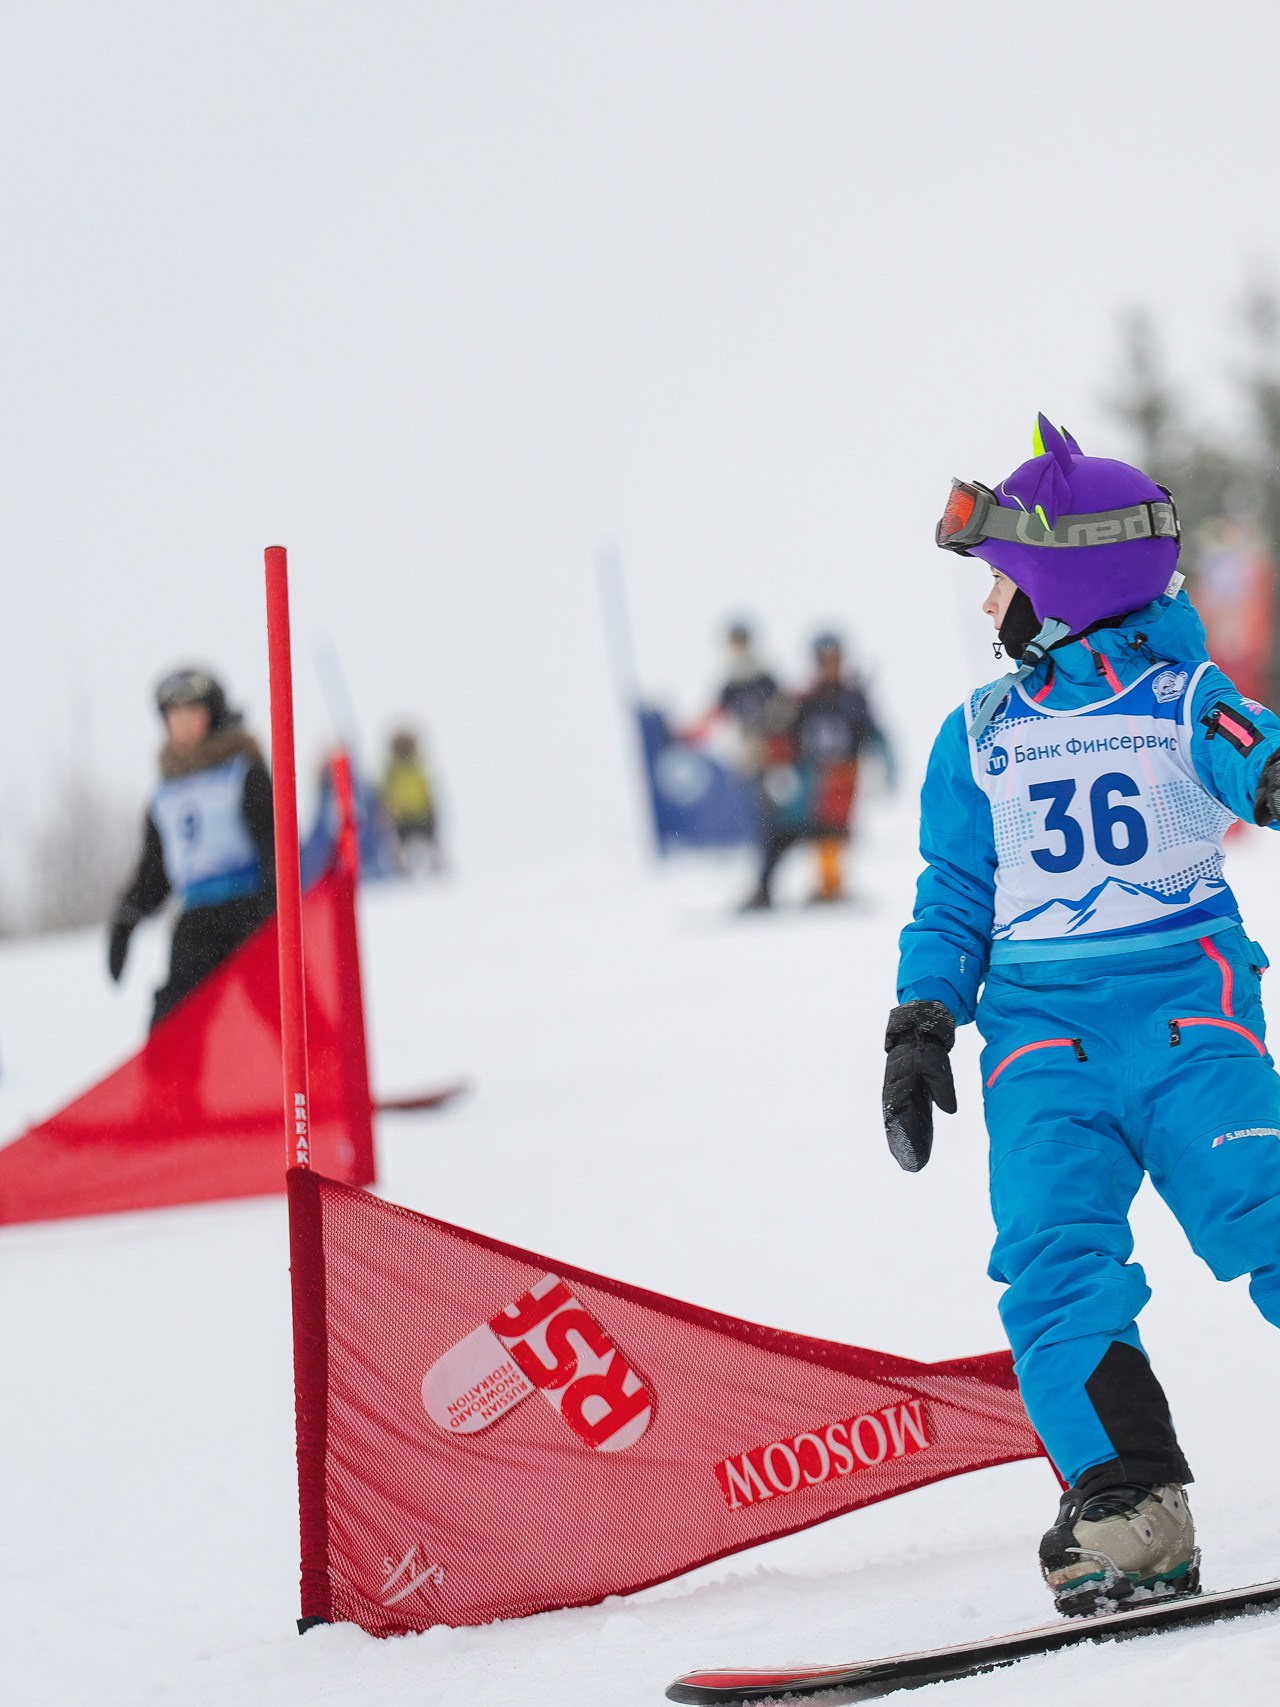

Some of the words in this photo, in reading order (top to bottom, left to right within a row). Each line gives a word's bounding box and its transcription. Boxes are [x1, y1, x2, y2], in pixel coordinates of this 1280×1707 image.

[1015, 743, 1062, 764] Банк
[1065, 734, 1178, 755] Финсервис
[1028, 771, 1149, 874] 36
[294, 1092, 309, 1169] BREAK
[447, 1361, 512, 1414] FEDERATION
[488, 1281, 652, 1450] RSF
[450, 1373, 521, 1428] SNOWBOARD
[481, 1381, 528, 1421] RUSSIAN
[725, 1400, 931, 1509] MOSCOW
